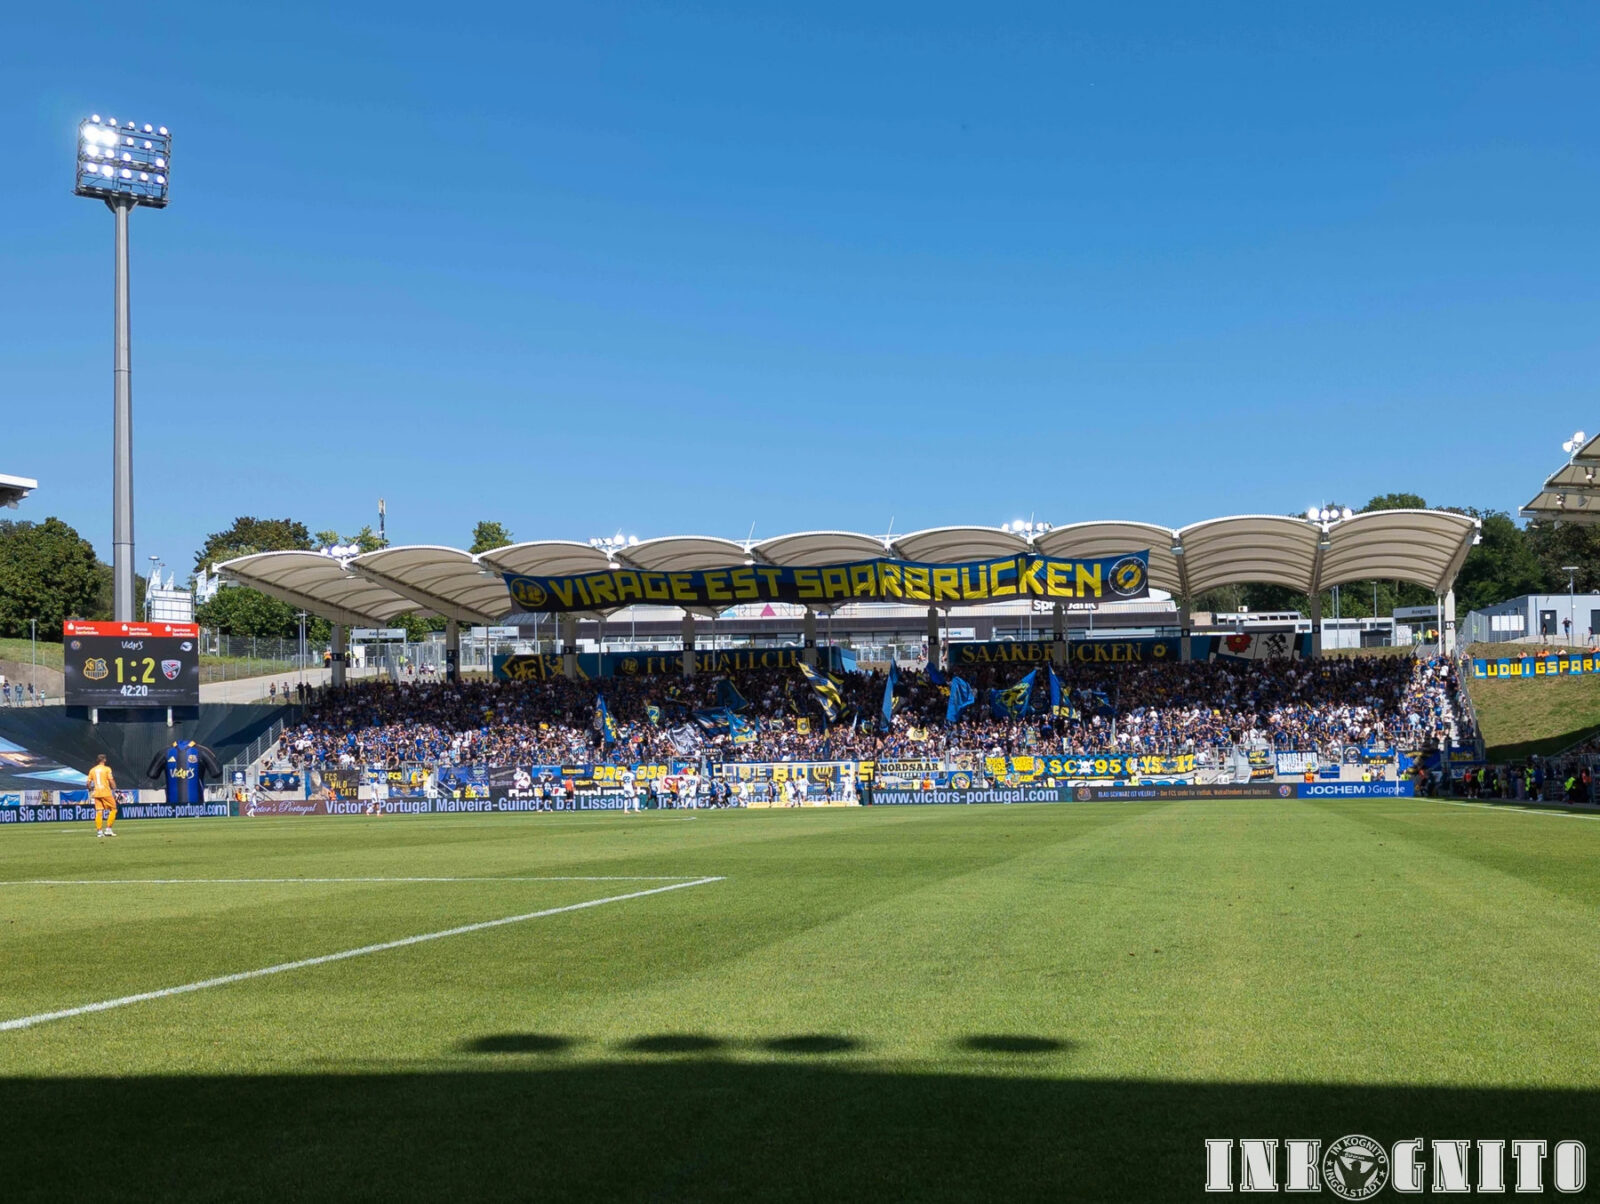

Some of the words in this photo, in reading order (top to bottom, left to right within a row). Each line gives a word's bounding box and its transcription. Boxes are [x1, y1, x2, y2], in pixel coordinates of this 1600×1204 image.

[548, 572, 698, 607] VIRAGE
[703, 568, 782, 600] EST
[793, 558, 1102, 601] SAARBRÜCKEN
[120, 685, 149, 697] 42:20
[880, 763, 939, 772] NORDSAAR
[1094, 759, 1121, 774] 95
[873, 788, 1059, 805] www.victors-portugal.com
[1306, 785, 1366, 795] JOCHEM
[1374, 784, 1406, 797] Gruppe
[19, 806, 36, 822] Sie
[37, 805, 57, 820] sich
[59, 804, 73, 819] ins
[122, 802, 227, 818] www.victors-portugal.com
[326, 800, 374, 814] Victor's
[379, 799, 432, 815] Portugal
